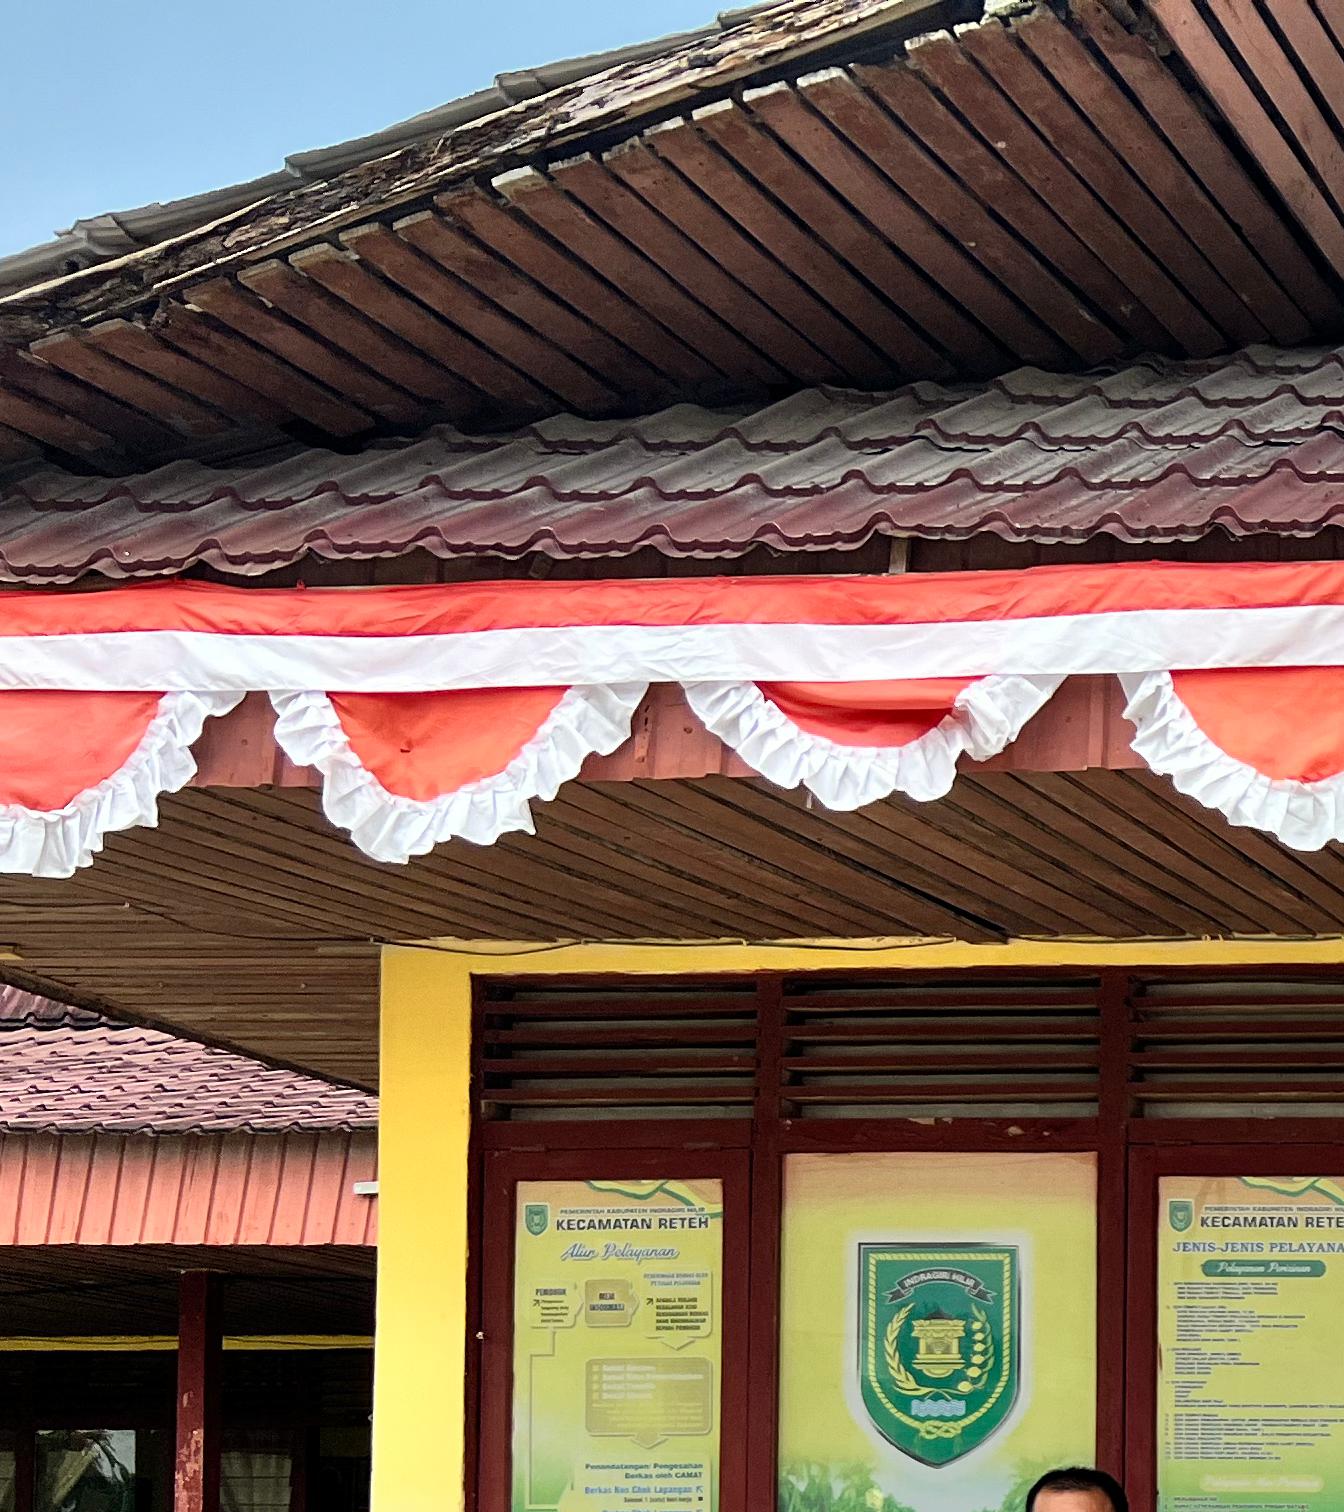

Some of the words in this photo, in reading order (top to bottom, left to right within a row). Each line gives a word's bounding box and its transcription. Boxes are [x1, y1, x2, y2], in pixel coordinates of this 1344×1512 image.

[556, 1218, 651, 1231] KECAMATAN
[658, 1217, 709, 1230] RETEH
[1200, 1216, 1298, 1229] KECAMATAN
[562, 1243, 598, 1261] Alur
[601, 1243, 680, 1264] Pelayanan
[1172, 1242, 1265, 1253] JENIS-JENIS
[903, 1271, 950, 1287] INDRAGIRI
